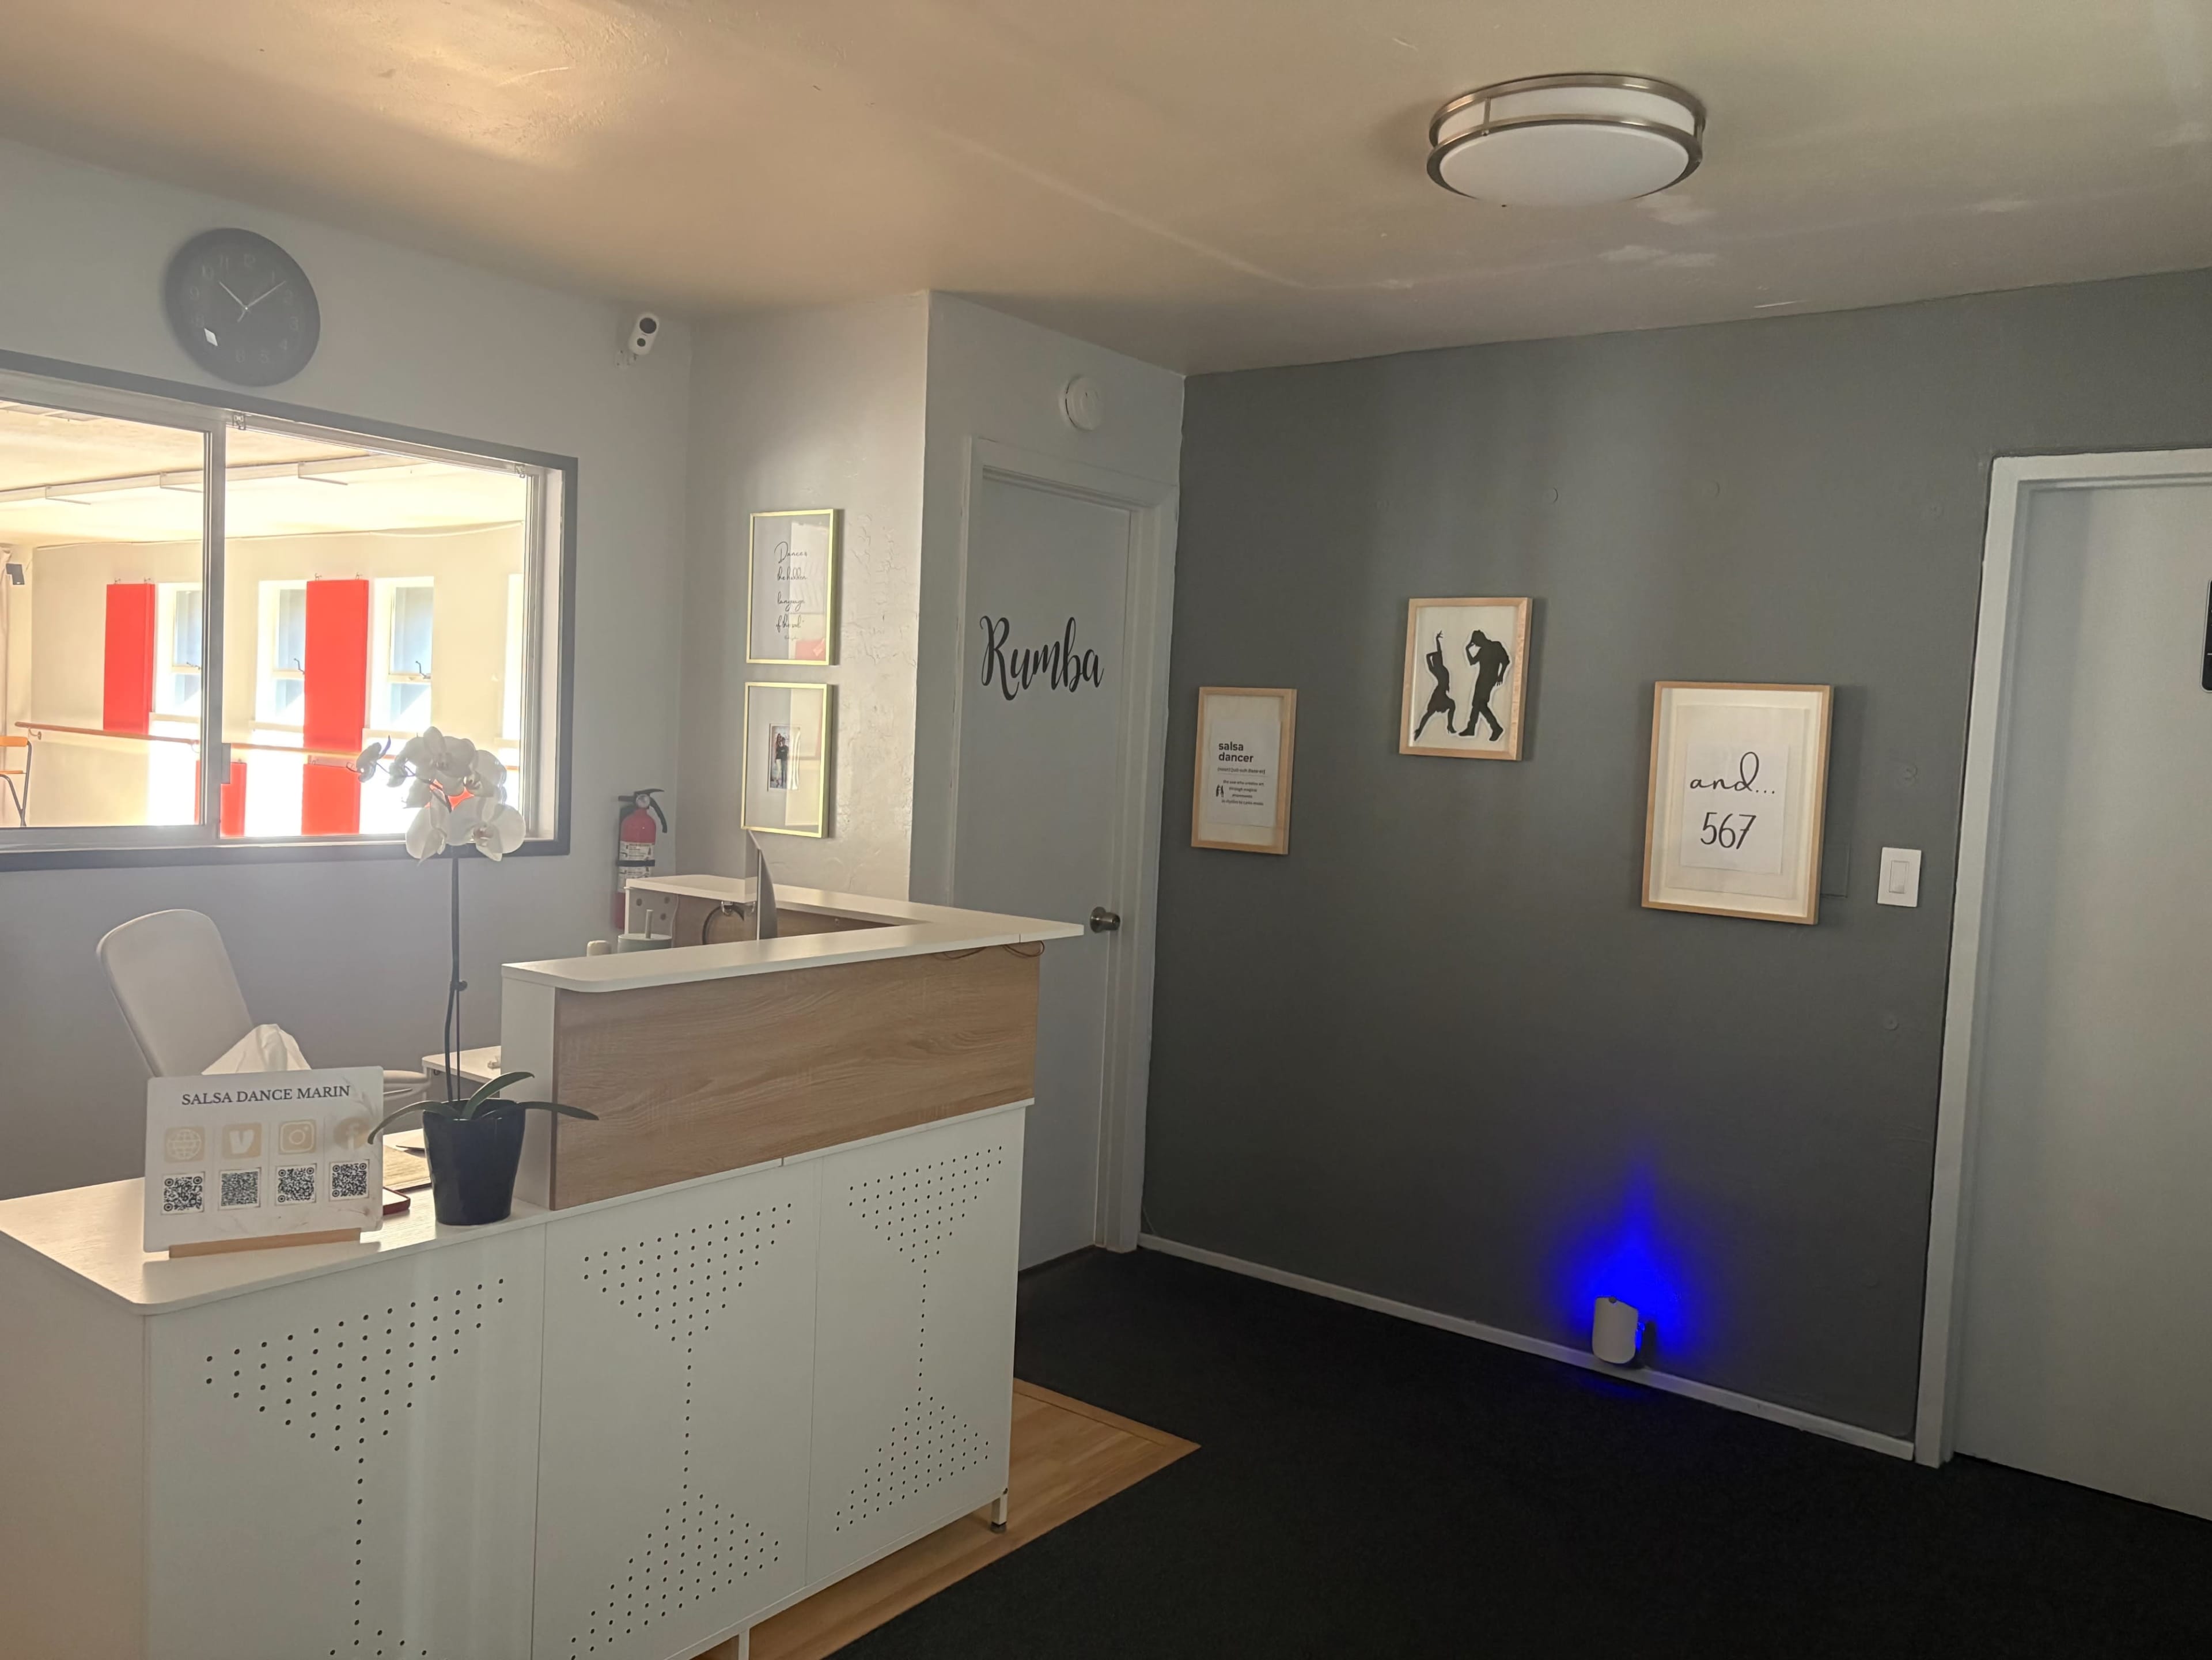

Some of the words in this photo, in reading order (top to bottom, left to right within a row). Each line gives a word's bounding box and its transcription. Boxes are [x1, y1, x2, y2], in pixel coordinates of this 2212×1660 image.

[979, 615, 1104, 701] Rumba
[1218, 741, 1244, 751] salsa
[1218, 752, 1253, 763] dancer
[1700, 812, 1757, 850] 567
[181, 1092, 232, 1105] SALSA
[236, 1088, 293, 1103] DANCE
[296, 1085, 350, 1099] MARIN
